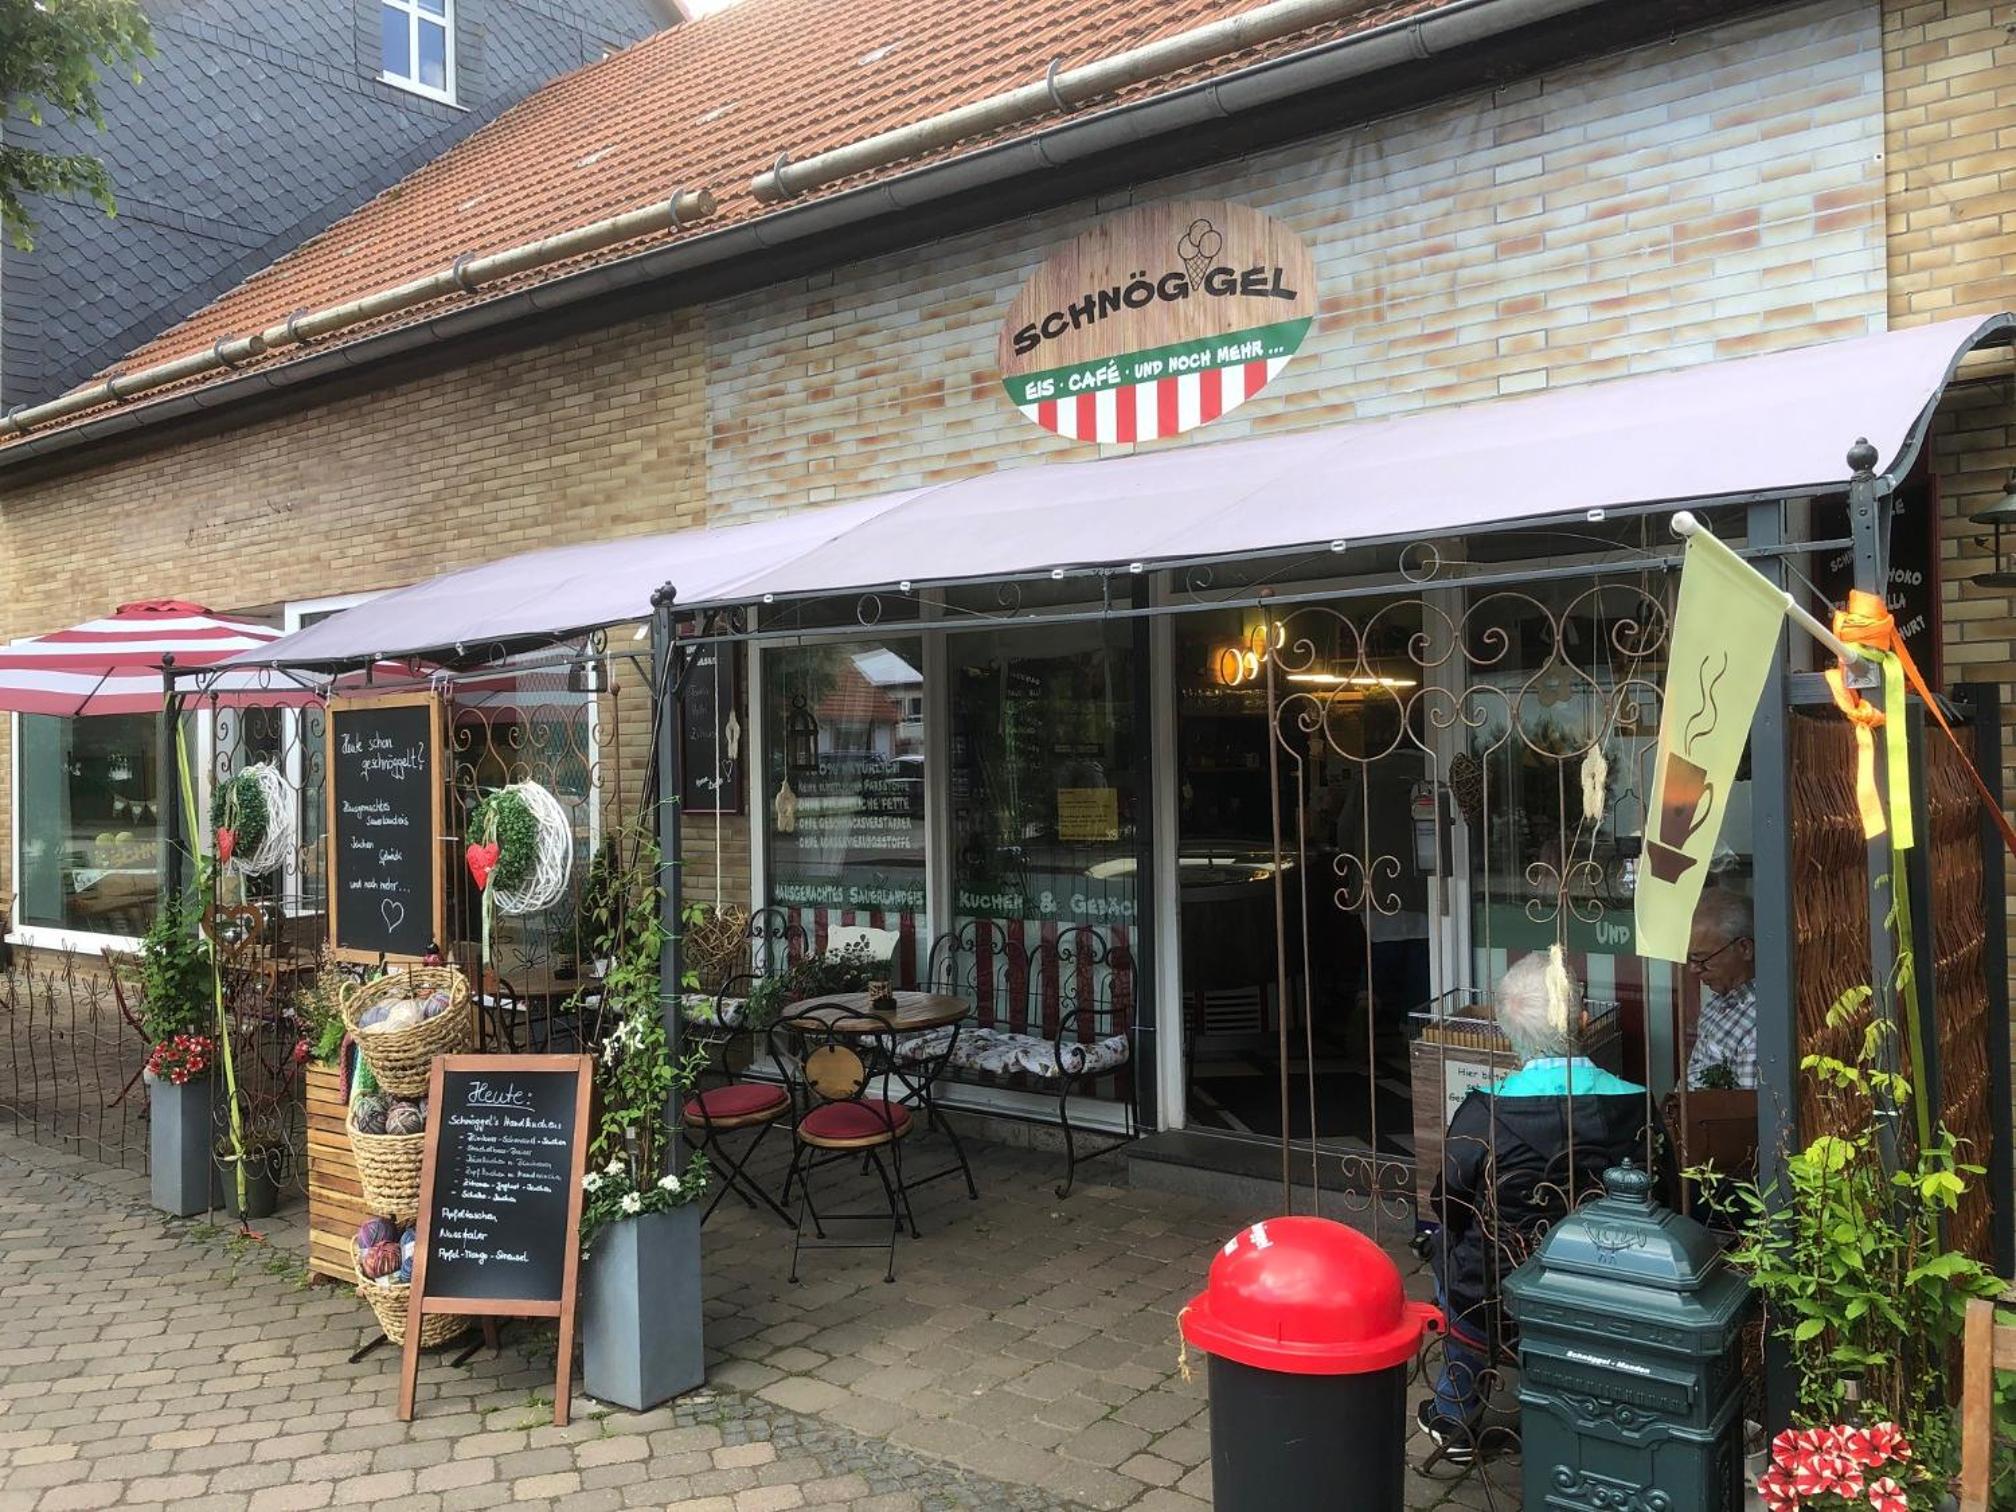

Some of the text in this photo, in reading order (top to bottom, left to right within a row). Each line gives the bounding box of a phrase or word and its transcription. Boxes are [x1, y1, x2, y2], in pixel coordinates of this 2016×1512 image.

[1025, 379, 1054, 400] EIS
[1068, 360, 1121, 392] CAFÉ
[1134, 361, 1162, 380] UND
[1168, 353, 1211, 373] NOCH
[1217, 340, 1264, 364] MEHR
[959, 890, 1023, 911] KUCHEN
[1040, 889, 1056, 914] &
[1595, 921, 1630, 945] UND
[468, 1082, 533, 1106] Heute:
